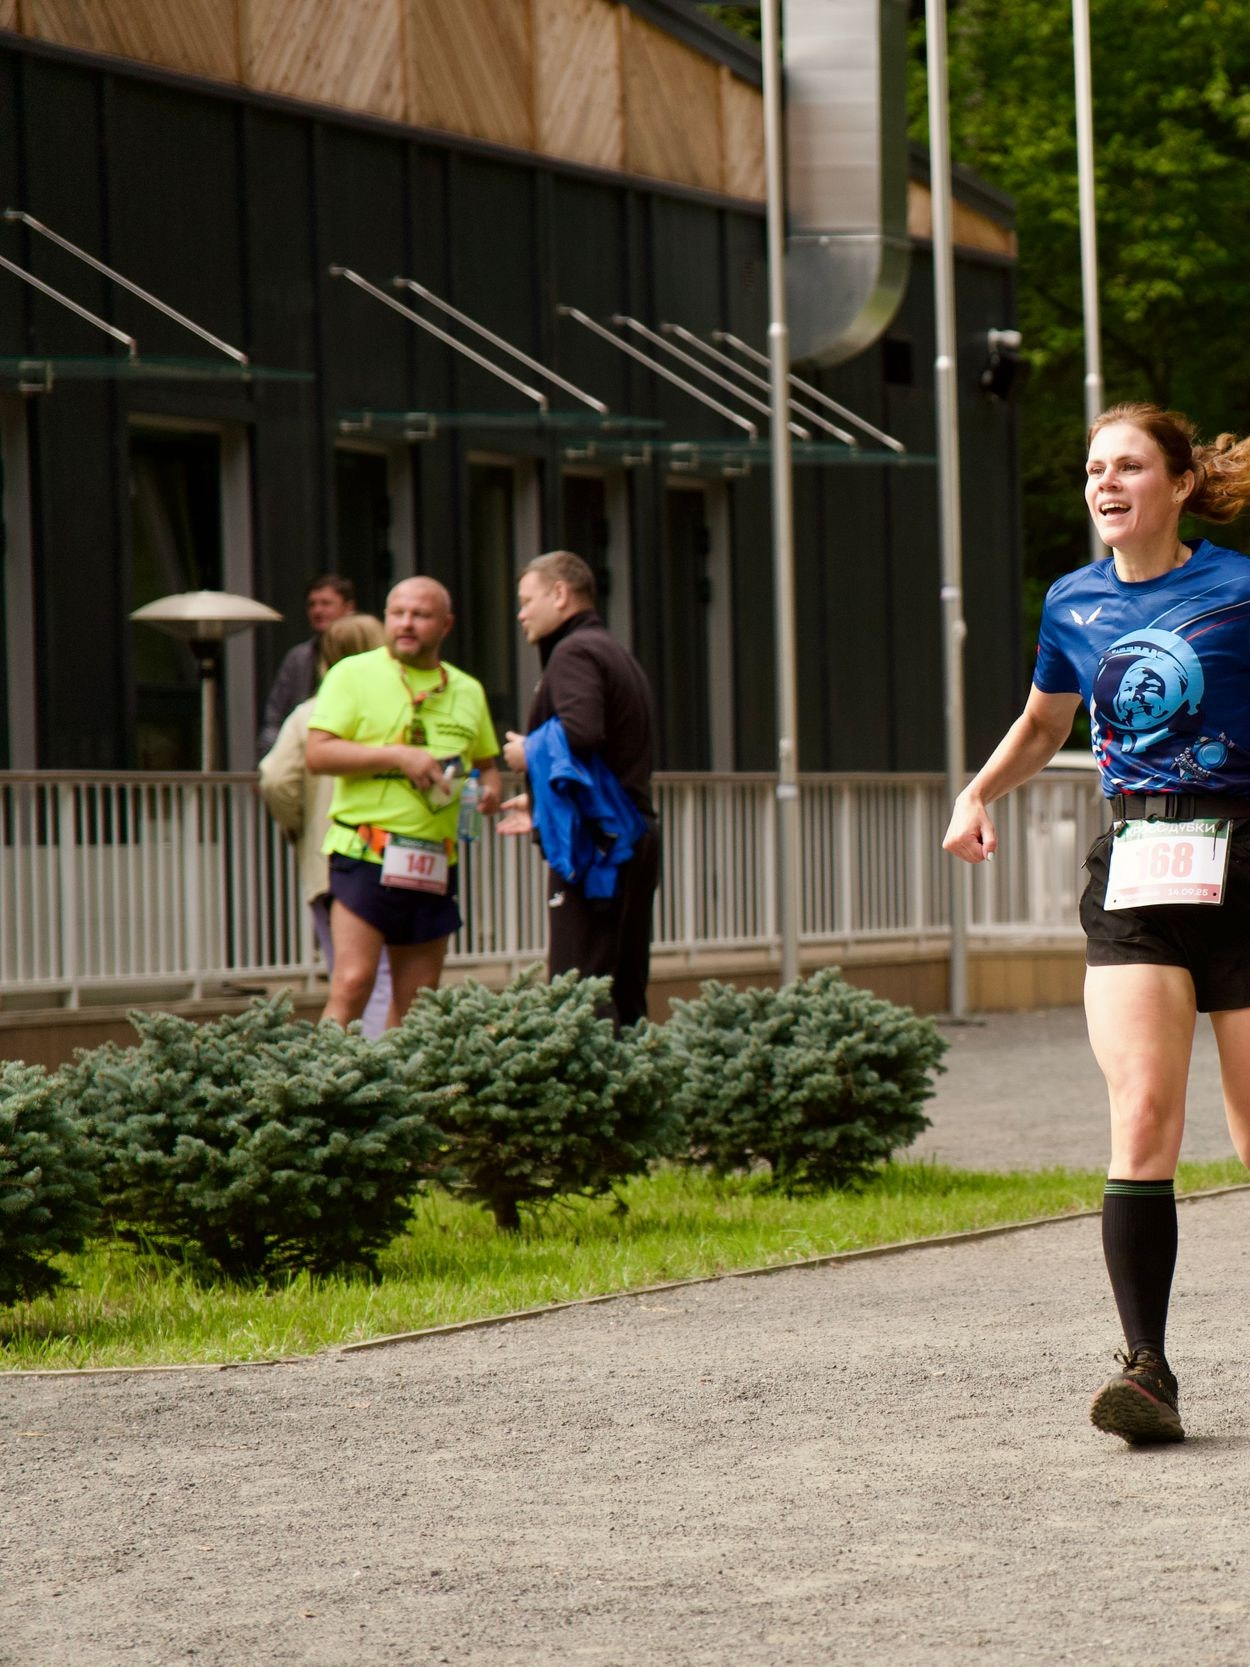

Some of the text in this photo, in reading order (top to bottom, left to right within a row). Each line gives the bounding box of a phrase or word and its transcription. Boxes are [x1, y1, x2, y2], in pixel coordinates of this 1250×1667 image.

[1169, 823, 1216, 834] ДУБКИ
[406, 852, 436, 876] 147
[1136, 842, 1195, 880] 168
